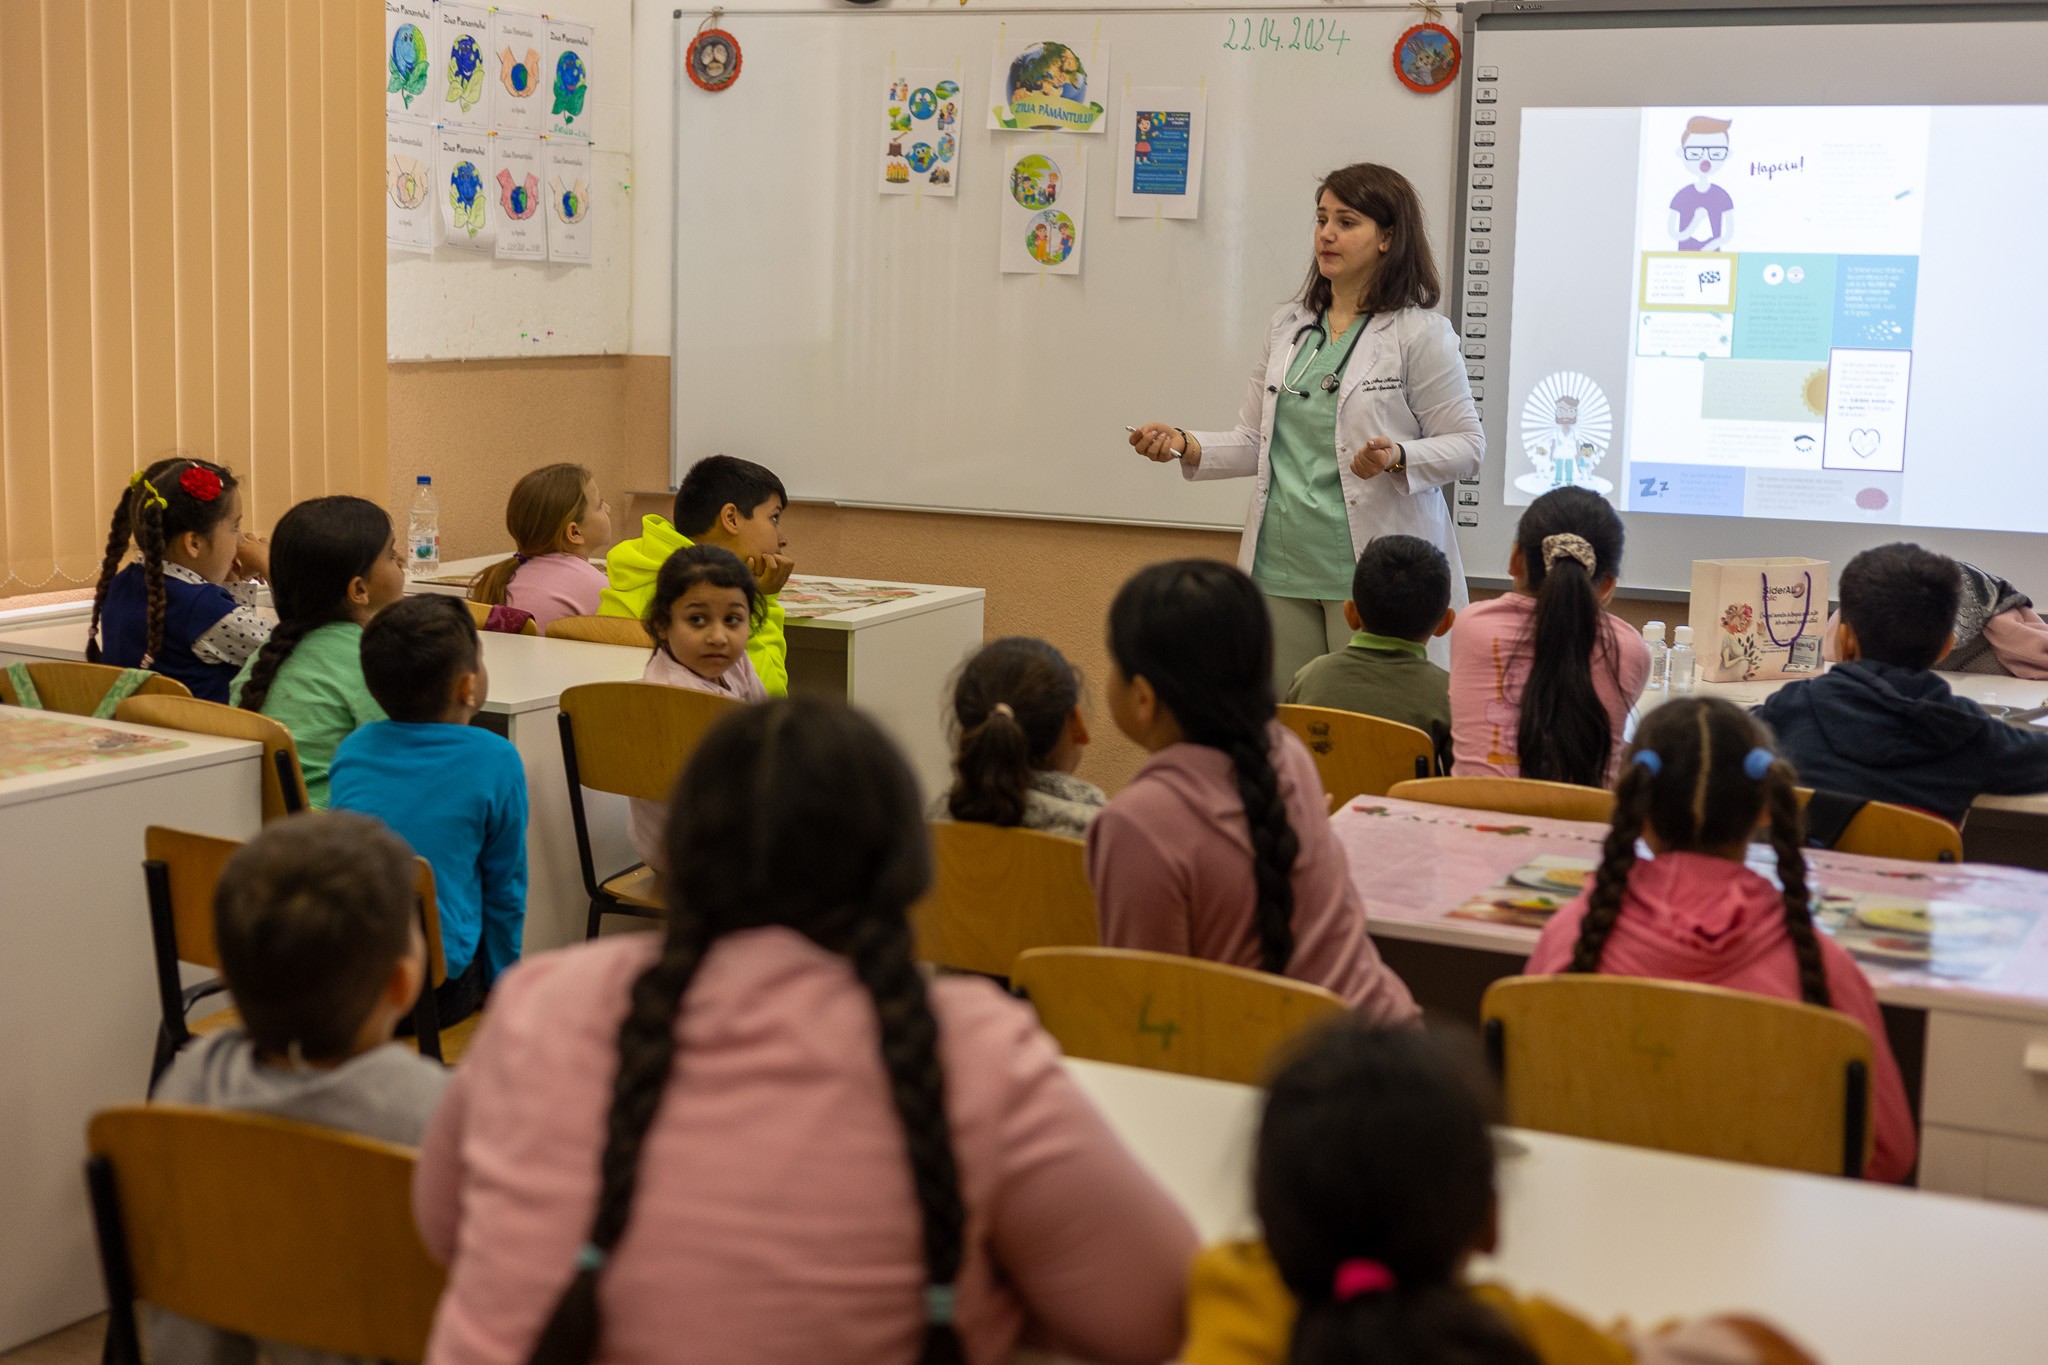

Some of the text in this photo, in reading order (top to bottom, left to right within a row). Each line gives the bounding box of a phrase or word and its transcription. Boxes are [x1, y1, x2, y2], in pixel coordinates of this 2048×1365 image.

[1223, 16, 1351, 56] 22.04.2024
[1015, 102, 1036, 114] ZIUA
[1137, 992, 1181, 1051] 4
